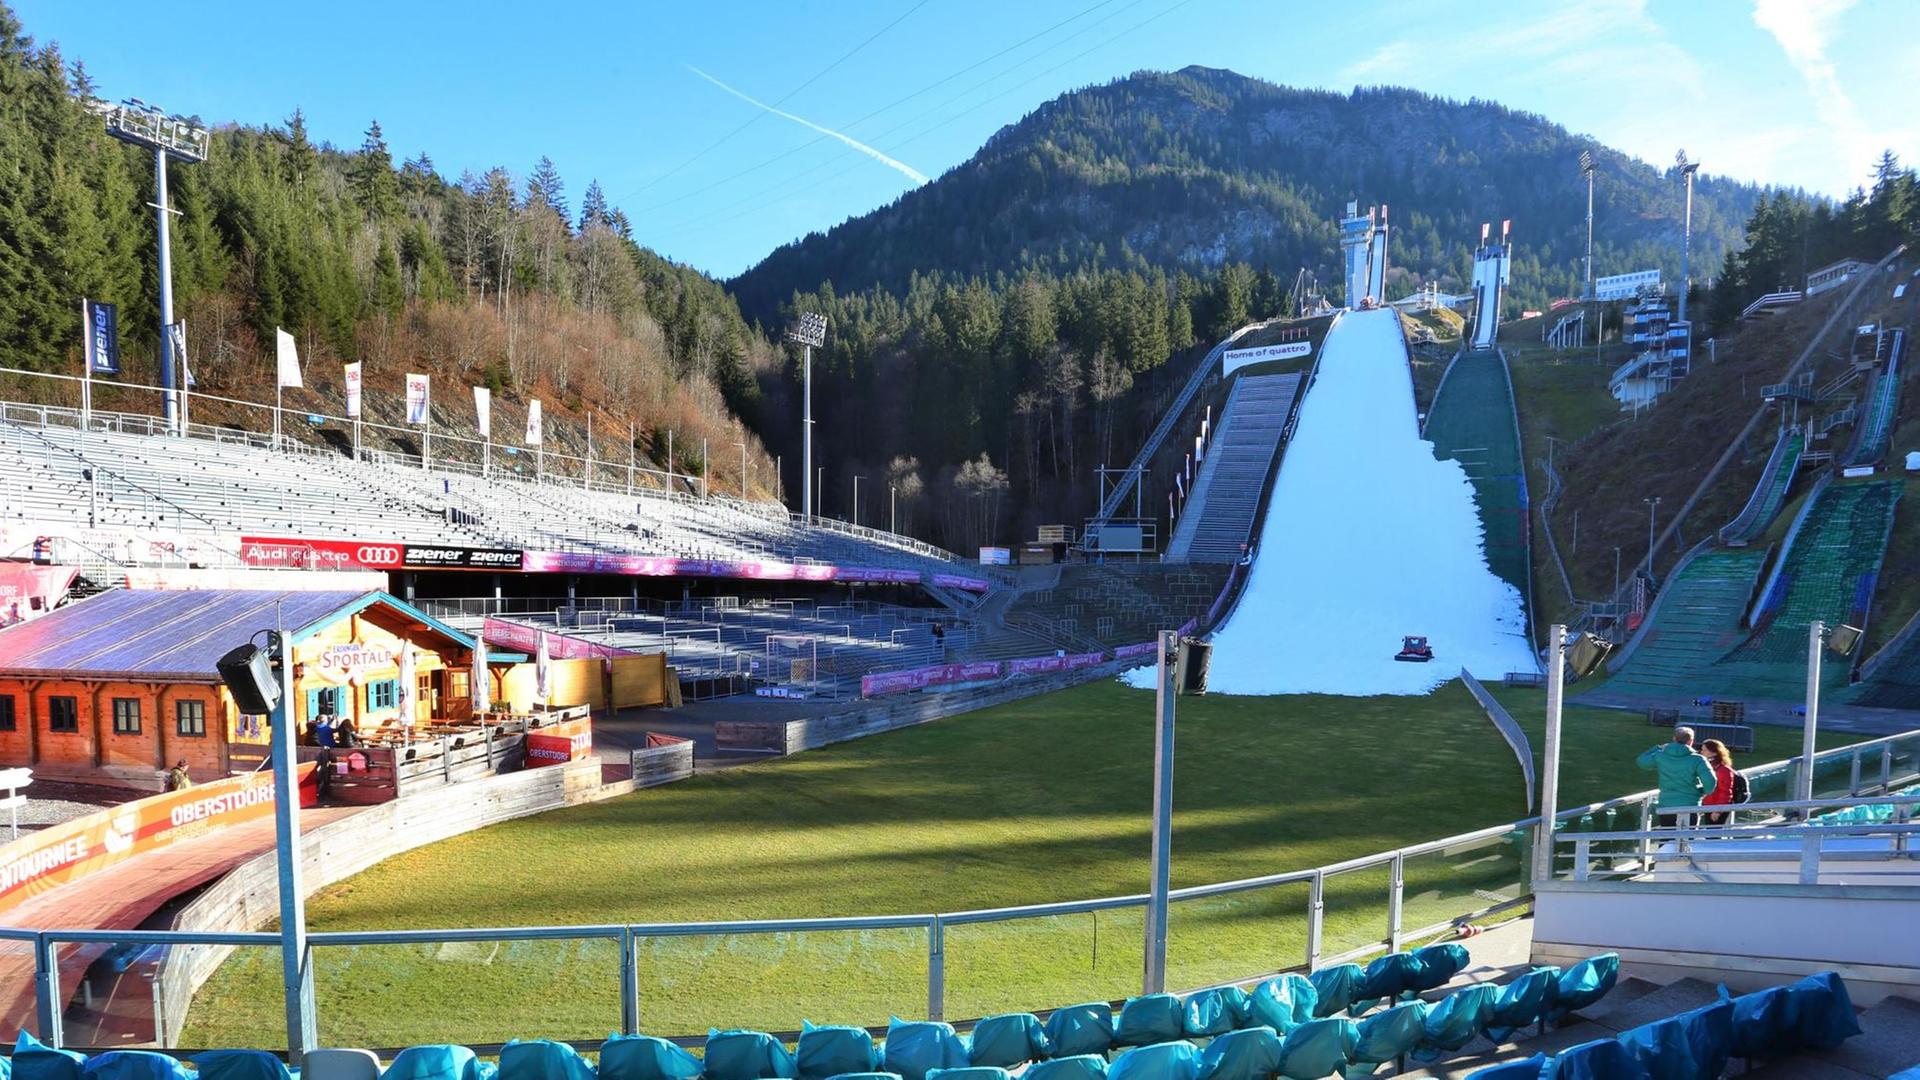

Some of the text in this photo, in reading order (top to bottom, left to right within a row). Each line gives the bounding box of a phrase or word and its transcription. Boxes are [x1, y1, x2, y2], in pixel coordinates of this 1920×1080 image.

[94, 304, 109, 367] ziener
[1226, 344, 1306, 360] Home of quattro
[247, 546, 287, 560] Audi
[405, 548, 463, 560] ziener
[470, 551, 521, 563] ziener
[322, 650, 392, 669] SPORTALP
[529, 748, 570, 761] OBERSTDORF
